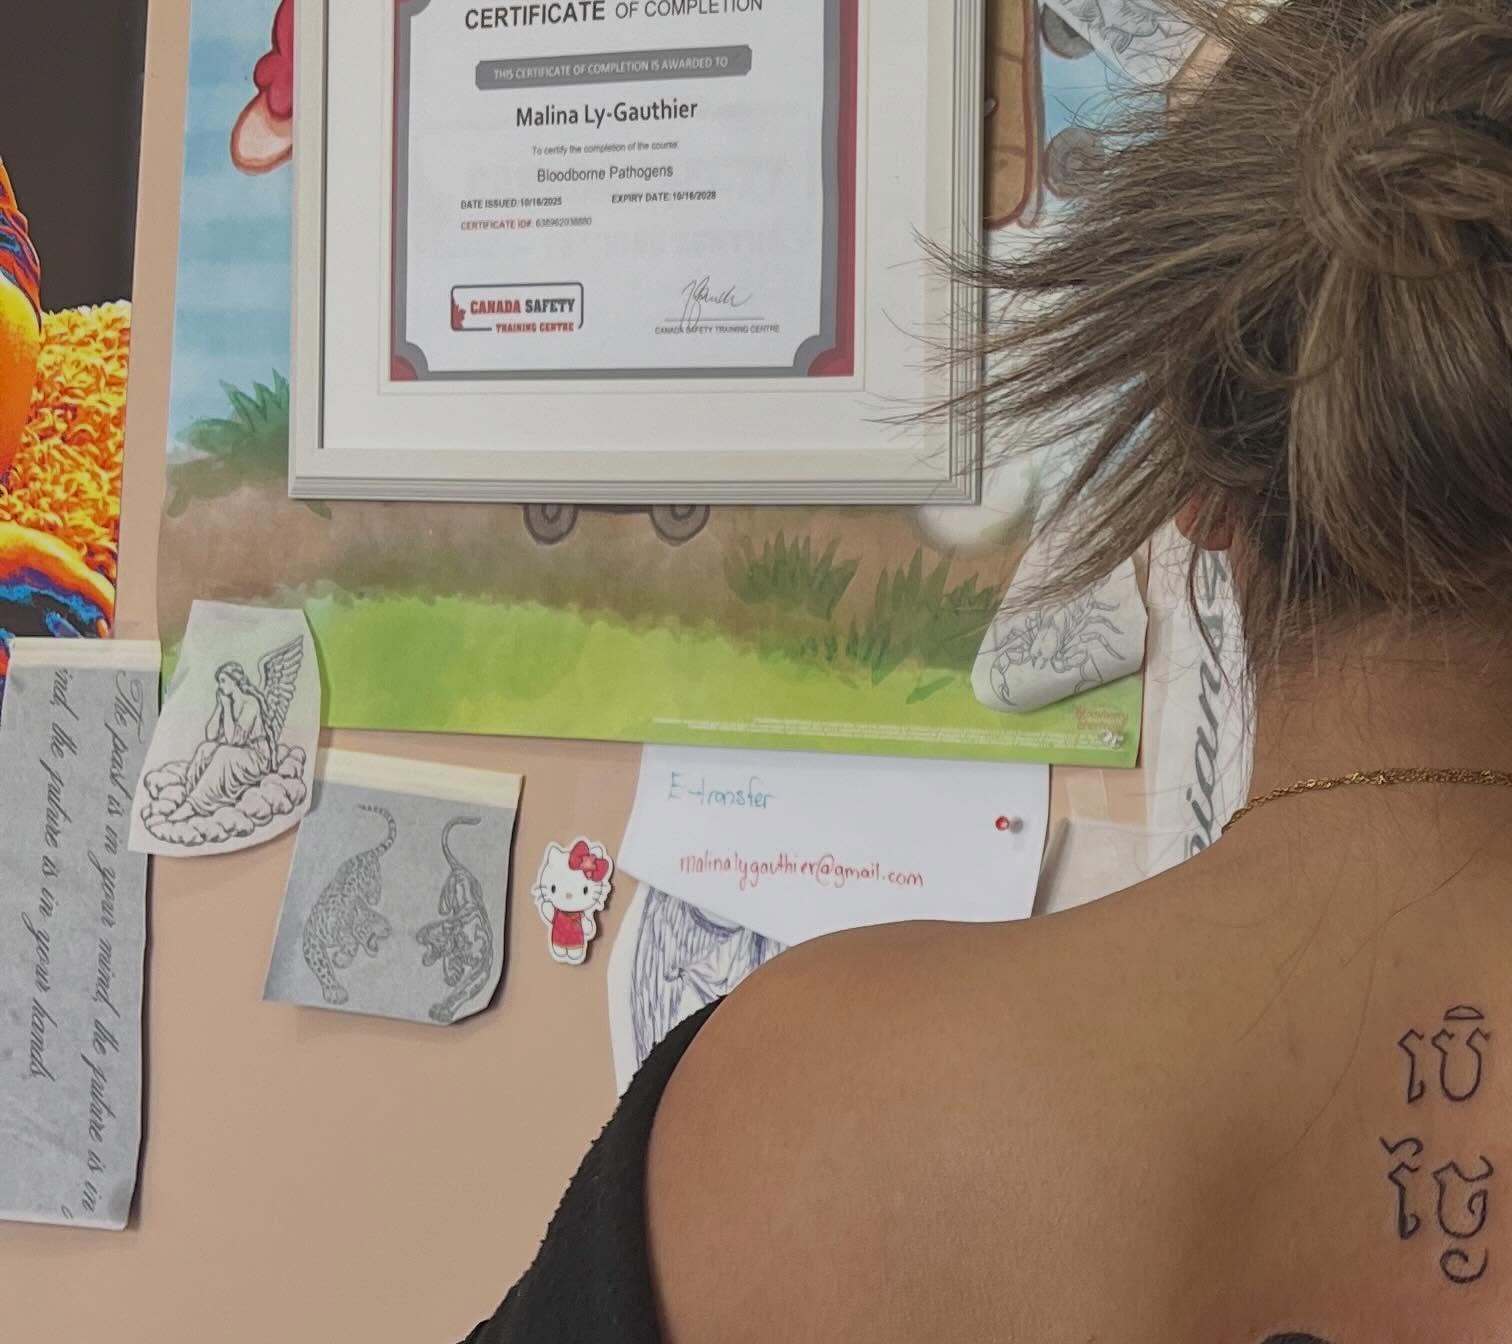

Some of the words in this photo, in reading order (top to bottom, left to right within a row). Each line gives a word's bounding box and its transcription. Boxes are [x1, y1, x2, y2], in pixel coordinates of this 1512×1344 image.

[465, 0, 606, 31] CERTIFICATE
[615, 1, 640, 20] OF
[494, 68, 514, 81] THIS
[515, 66, 571, 80] CERTIFICATE
[573, 64, 587, 76] OF
[587, 60, 649, 75] COMPLETION
[651, 59, 660, 71] IS
[661, 57, 713, 70] AWARDED
[715, 56, 729, 68] TO
[516, 103, 579, 127] Malina
[584, 98, 698, 129] Ly-Gauthier
[532, 145, 542, 155] To
[543, 143, 568, 157] certify
[569, 142, 582, 154] the
[583, 142, 626, 156] completion
[627, 141, 636, 152] of
[637, 140, 650, 151] the
[537, 167, 606, 183] Bloodborne
[609, 164, 674, 182] Pathogens
[460, 199, 484, 210] DATE
[611, 193, 644, 205] EXPIRY
[460, 220, 515, 231] CERTIFICATE
[470, 299, 522, 314] CANADA
[524, 298, 576, 313] SAFETY
[495, 322, 537, 333] TRAINING
[539, 322, 574, 333] CENTRE
[654, 325, 685, 335] CANADA
[715, 324, 749, 334] TRAINING
[750, 323, 780, 333] CENTRE
[114, 670, 144, 742] The
[51, 723, 77, 758] the
[105, 723, 132, 798] past
[106, 795, 128, 819] is
[105, 828, 125, 856] in
[43, 855, 67, 878] is
[87, 851, 119, 928] your
[39, 887, 62, 919] in
[21, 912, 58, 994] your
[93, 1018, 119, 1054] the
[87, 1147, 110, 1172] is
[82, 1180, 105, 1212] in
